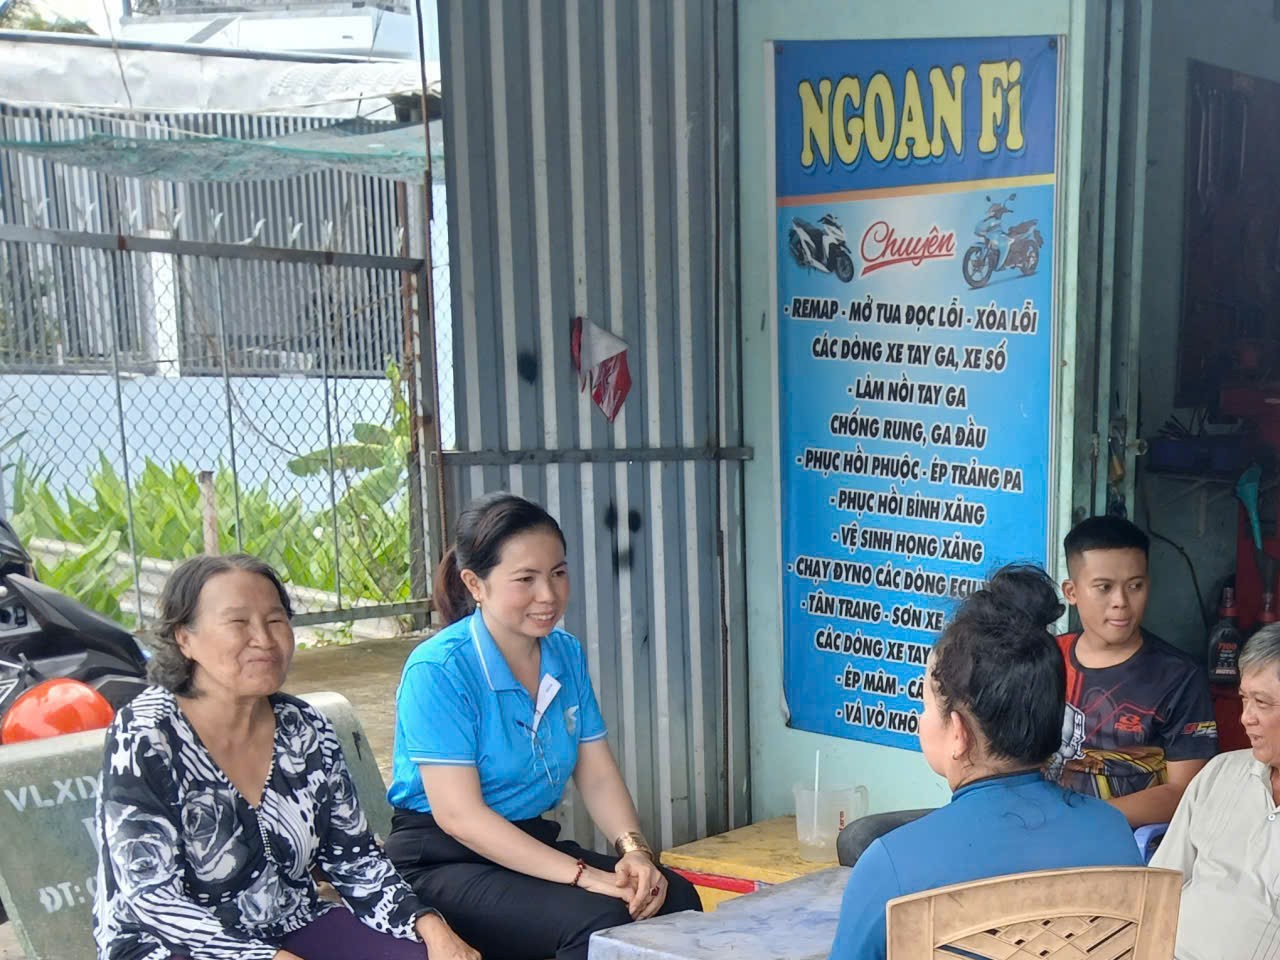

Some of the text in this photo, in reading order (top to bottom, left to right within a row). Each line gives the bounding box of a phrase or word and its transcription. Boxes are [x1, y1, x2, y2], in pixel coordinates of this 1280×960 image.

[798, 63, 967, 169] NGOAN
[860, 220, 956, 268] Chuyên
[792, 295, 1038, 333] REMAP MỞ TUA ĐỌC LỖI XÓA LỖI
[812, 333, 1007, 371] CÁC DÒNG XE TAY GA, XE SỐ
[855, 373, 966, 408] LÀM NỒI TAY GA
[831, 408, 986, 448] CHỐNG RUNG, GA ĐẦU
[804, 449, 841, 476] PHỤC
[843, 445, 869, 475] HỒI
[871, 454, 920, 485] PHUỘC
[930, 457, 948, 482] ÉP
[1003, 470, 1023, 491] PA
[838, 486, 985, 525] PHỤC HỒI BÌNH XĂNG
[841, 523, 982, 562] VỆ SINH HỌNG XĂNG
[796, 557, 831, 583] CHẠY
[875, 563, 901, 590] CÁC
[903, 567, 946, 595] DÒNG
[809, 591, 944, 631] TÂN TRANG SƠN XE
[816, 627, 931, 665] CÁC DÒNG XE TAY
[844, 665, 925, 699] ÉP MÂM CÂ
[845, 700, 920, 734] VÁ VỎ KHÔ
